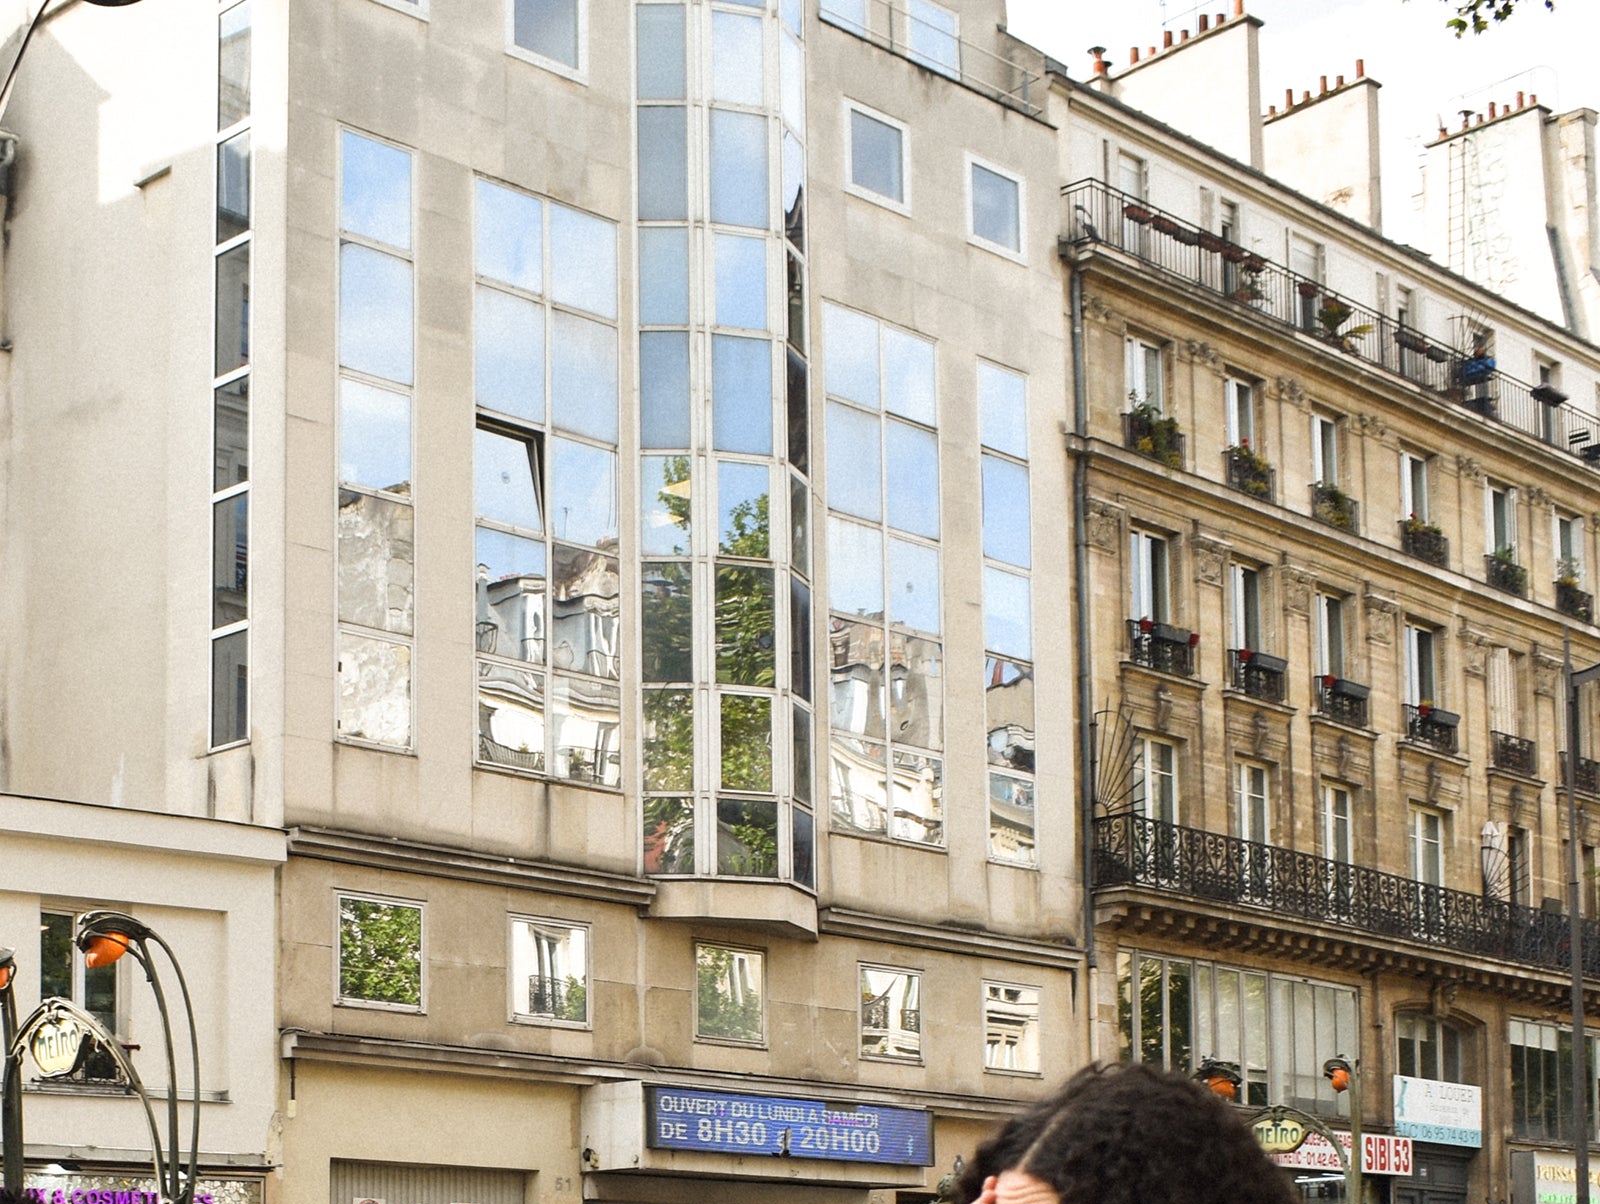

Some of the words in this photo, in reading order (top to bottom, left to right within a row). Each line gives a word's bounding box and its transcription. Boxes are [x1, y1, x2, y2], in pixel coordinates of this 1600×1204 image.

[660, 1095, 728, 1117] OUVERT
[731, 1101, 754, 1119] DU
[758, 1103, 805, 1123] LUNDI
[822, 1110, 879, 1129] SAMEDI
[660, 1121, 689, 1140] DE
[697, 1118, 767, 1146] 8H30
[800, 1125, 880, 1153] 20H00
[1365, 1136, 1391, 1171] SIBI
[1394, 1139, 1410, 1173] 53
